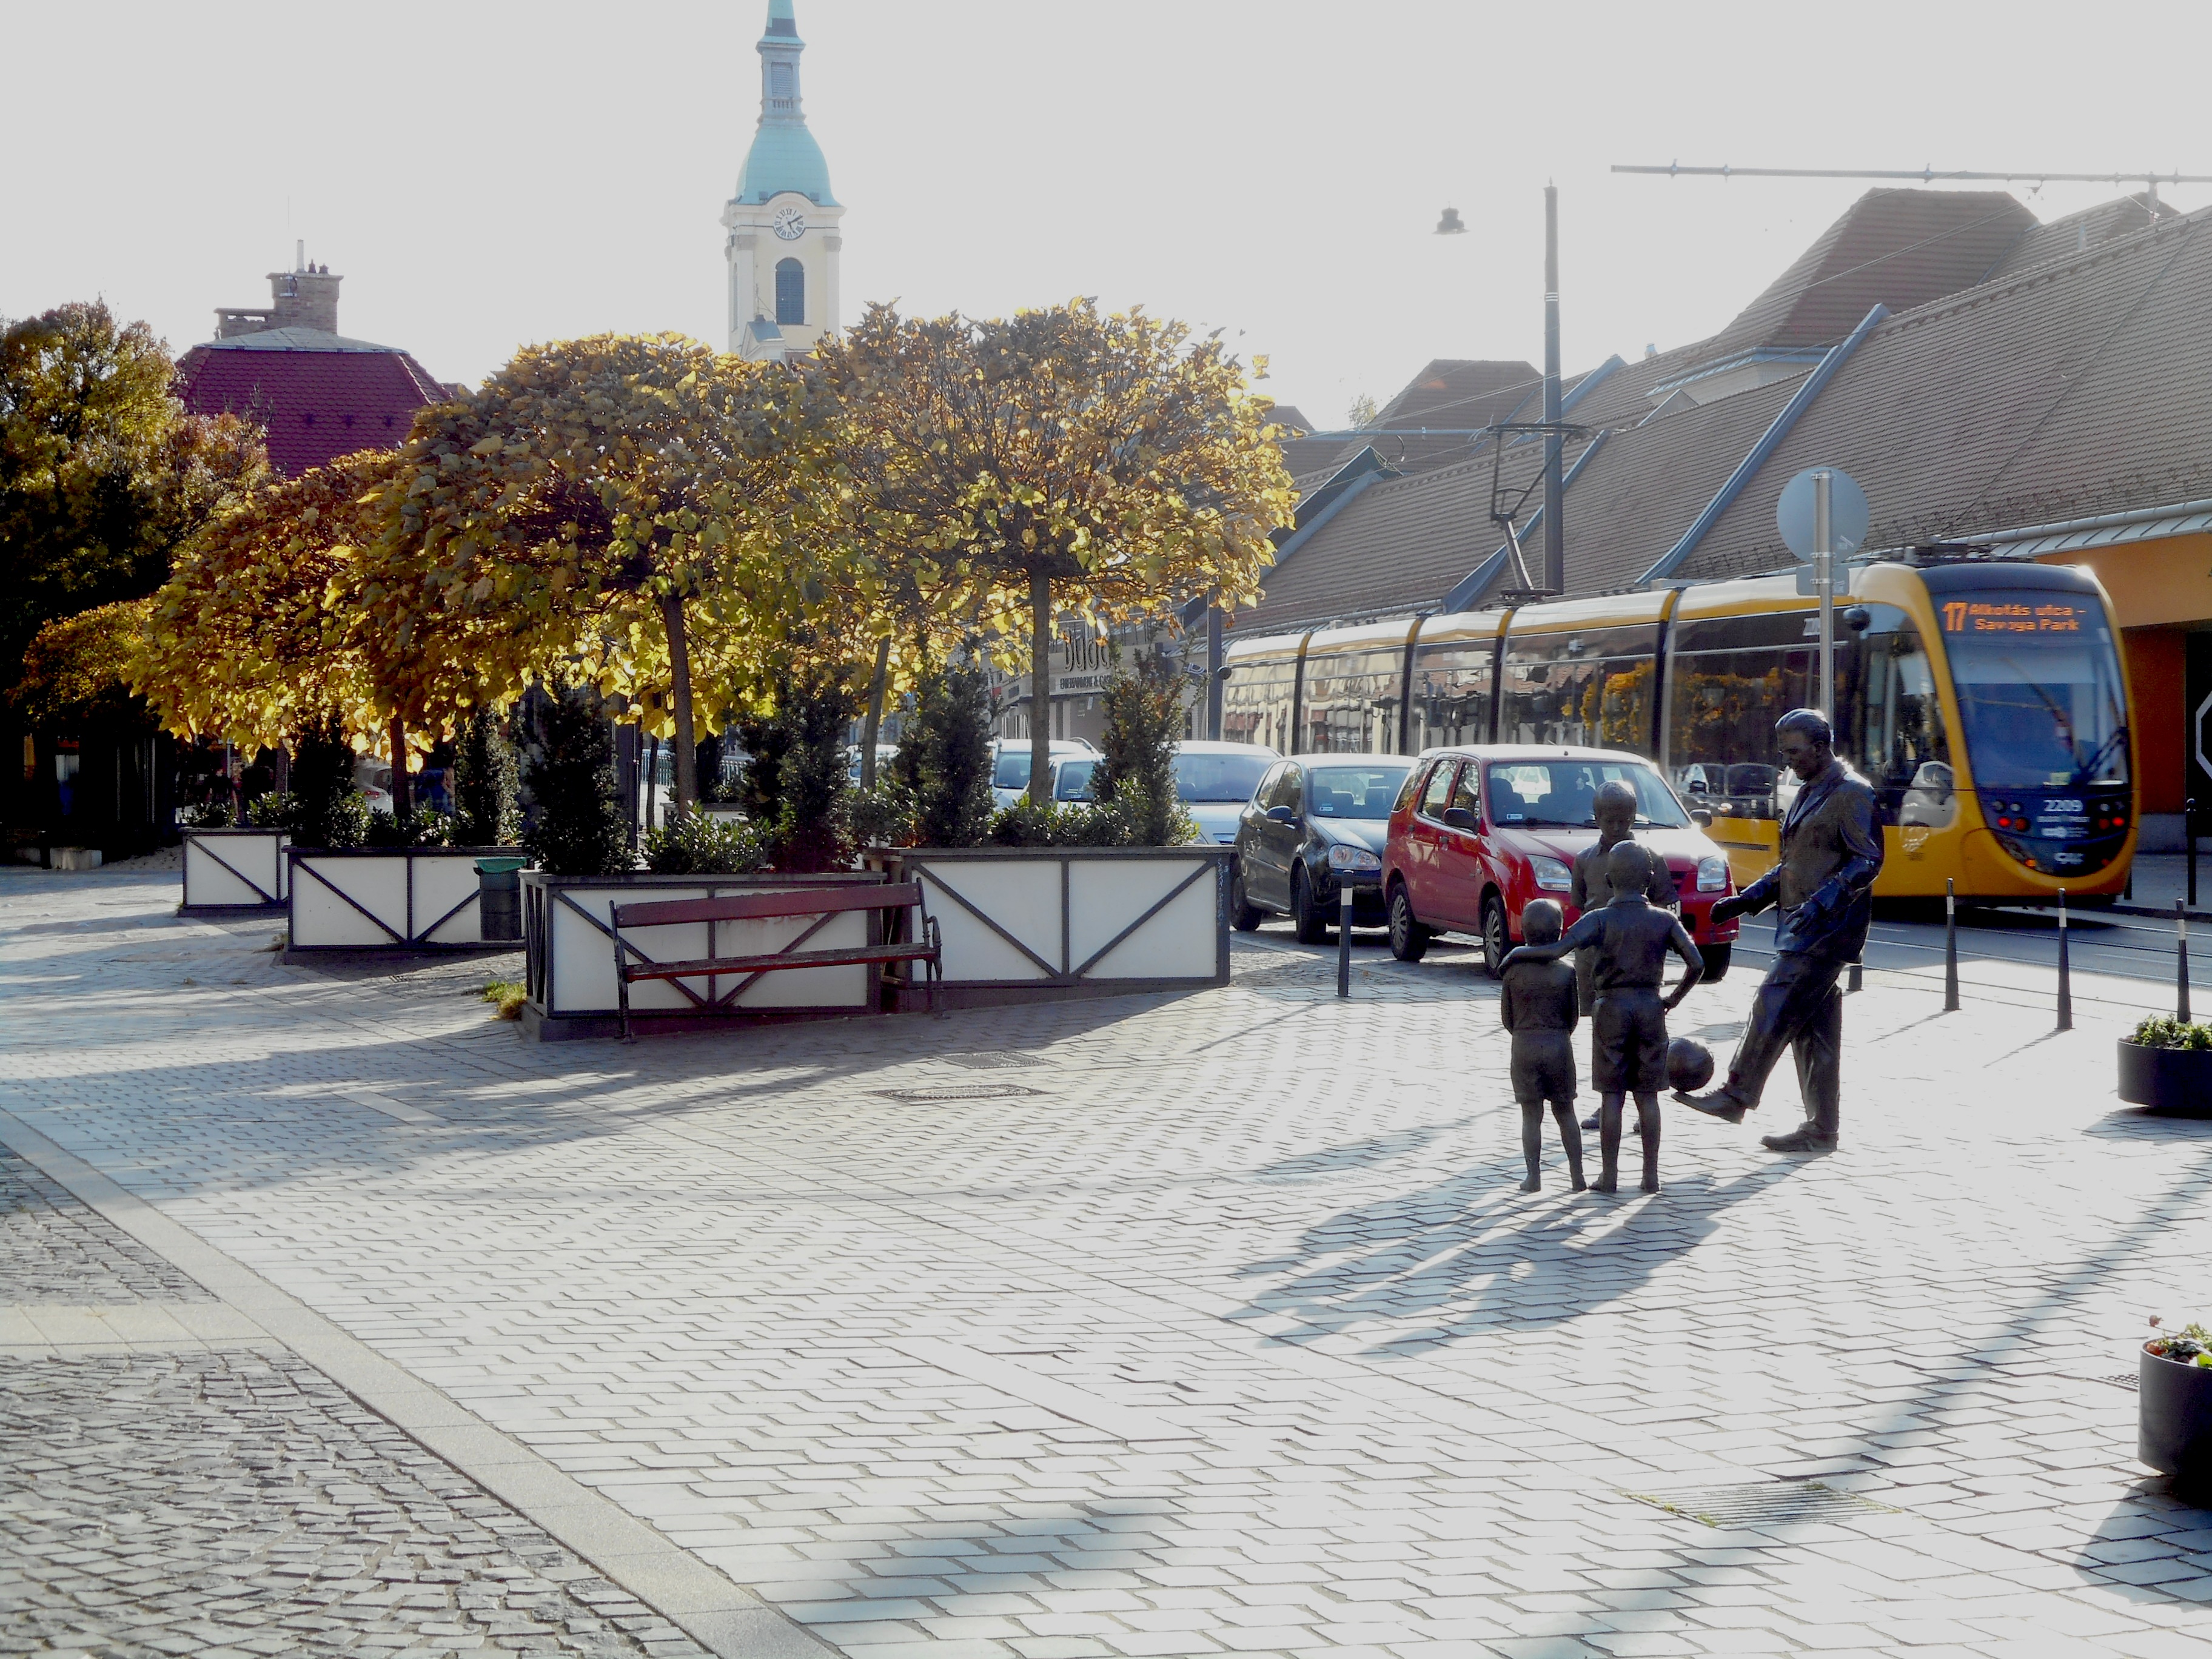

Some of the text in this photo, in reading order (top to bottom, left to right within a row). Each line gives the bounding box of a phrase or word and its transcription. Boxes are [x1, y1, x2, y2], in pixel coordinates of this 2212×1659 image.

[1942, 602, 1968, 631] 17
[2034, 605, 2073, 615] utca
[2039, 618, 2079, 631] Park
